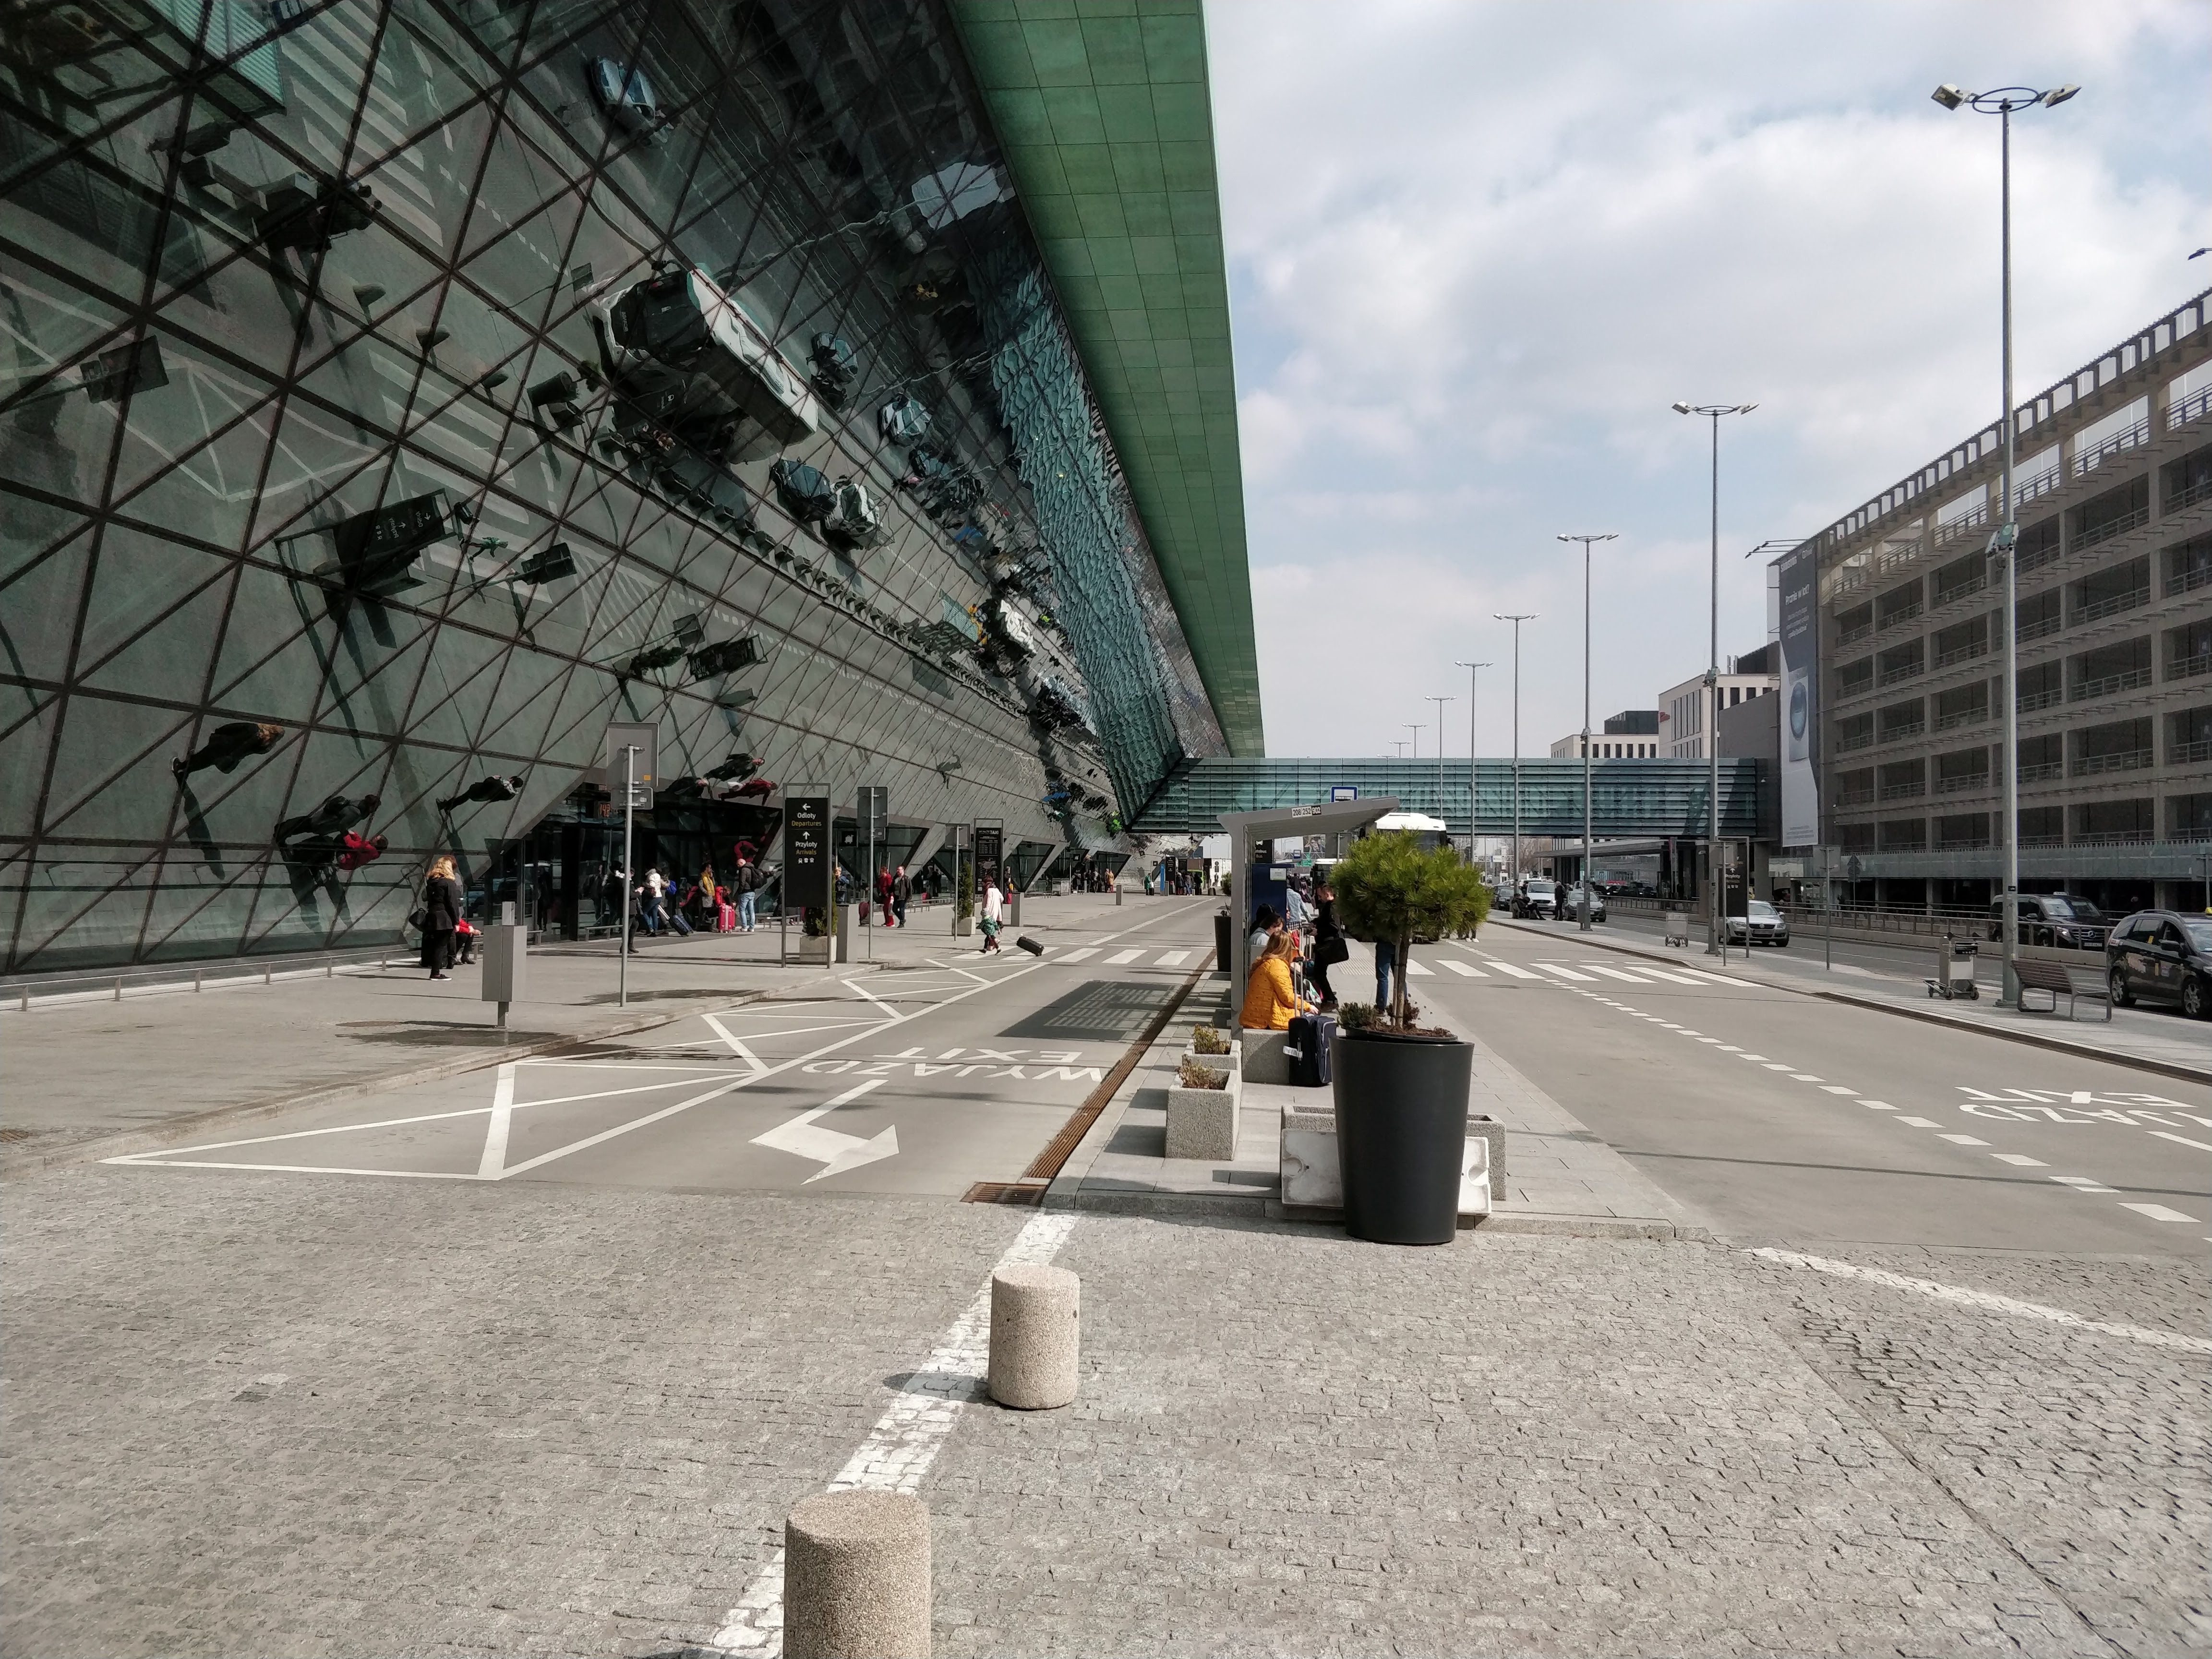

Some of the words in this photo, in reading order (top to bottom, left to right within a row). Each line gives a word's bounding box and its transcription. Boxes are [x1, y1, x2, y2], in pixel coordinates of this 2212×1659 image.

[872, 1047, 1083, 1063] EXIT
[801, 1060, 1103, 1082] WYJAZD
[1954, 1086, 2199, 1108] EXIT
